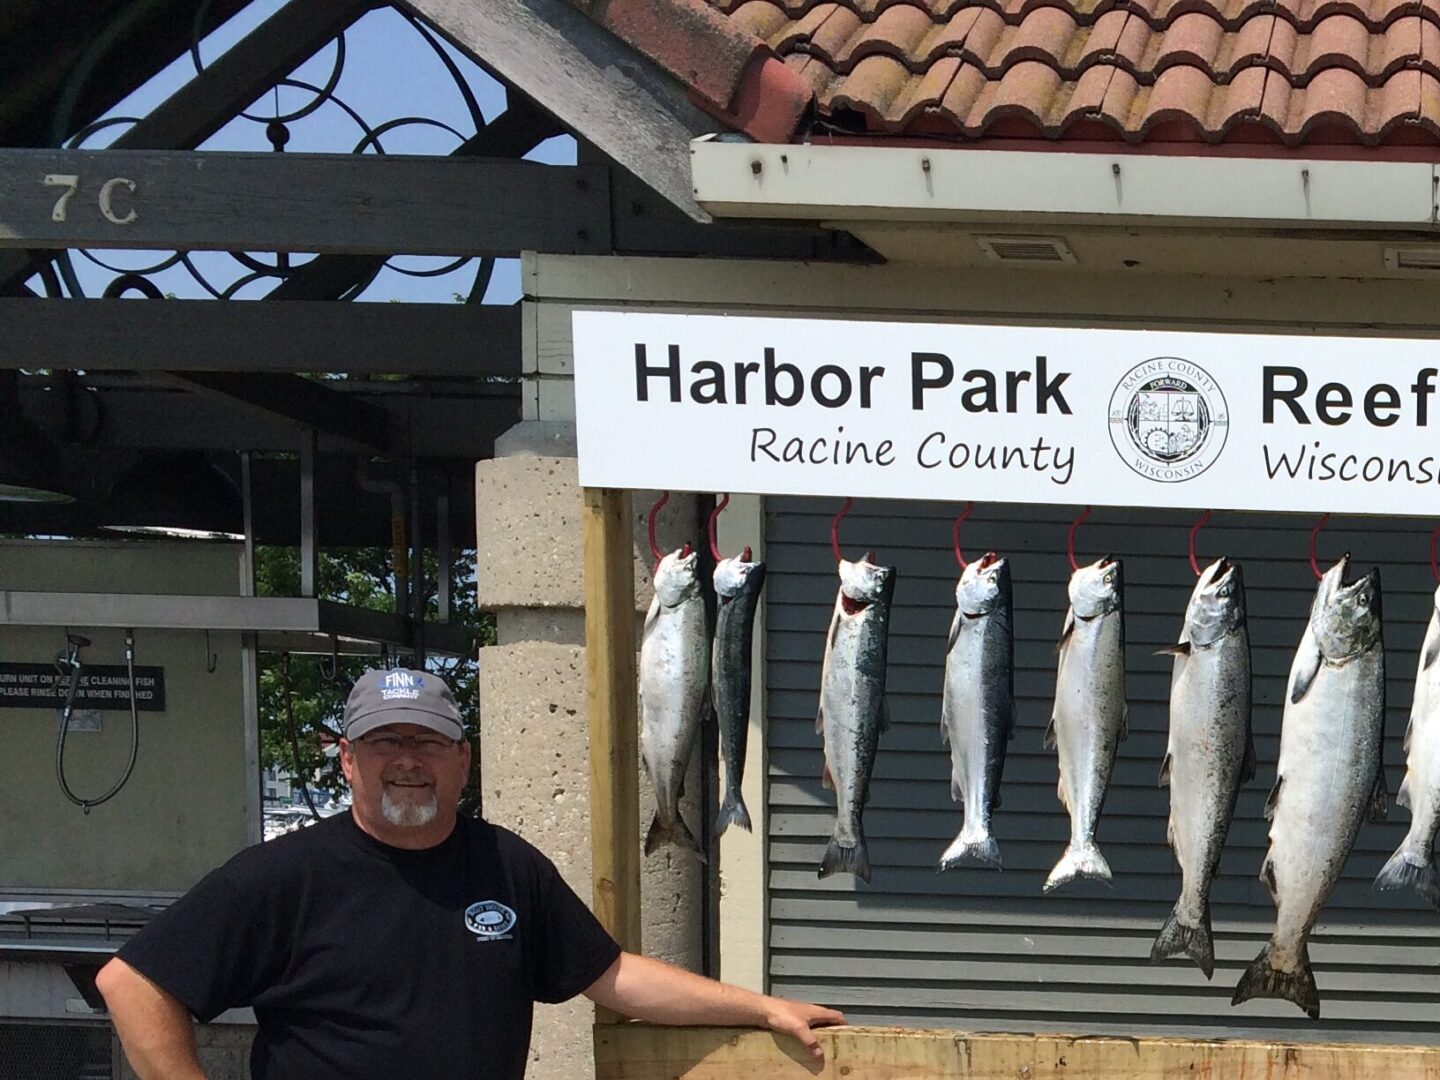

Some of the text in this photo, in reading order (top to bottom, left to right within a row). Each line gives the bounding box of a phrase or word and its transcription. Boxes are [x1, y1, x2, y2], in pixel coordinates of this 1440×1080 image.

[635, 344, 1072, 414] Harbor Park
[1122, 361, 1216, 393] RACINE COUNTY
[1150, 379, 1188, 390] FORWARD
[751, 428, 1074, 484] Racine County
[1134, 458, 1204, 479] WISCONSIN
[0, 673, 17, 683] URN
[18, 674, 39, 684] UNIT
[40, 674, 53, 684] ON
[55, 675, 89, 686] BEFRE
[135, 677, 155, 687] FISH
[385, 672, 414, 687] FINN
[0, 687, 153, 700] PLEASE RINSE DON WHEN FINIHED
